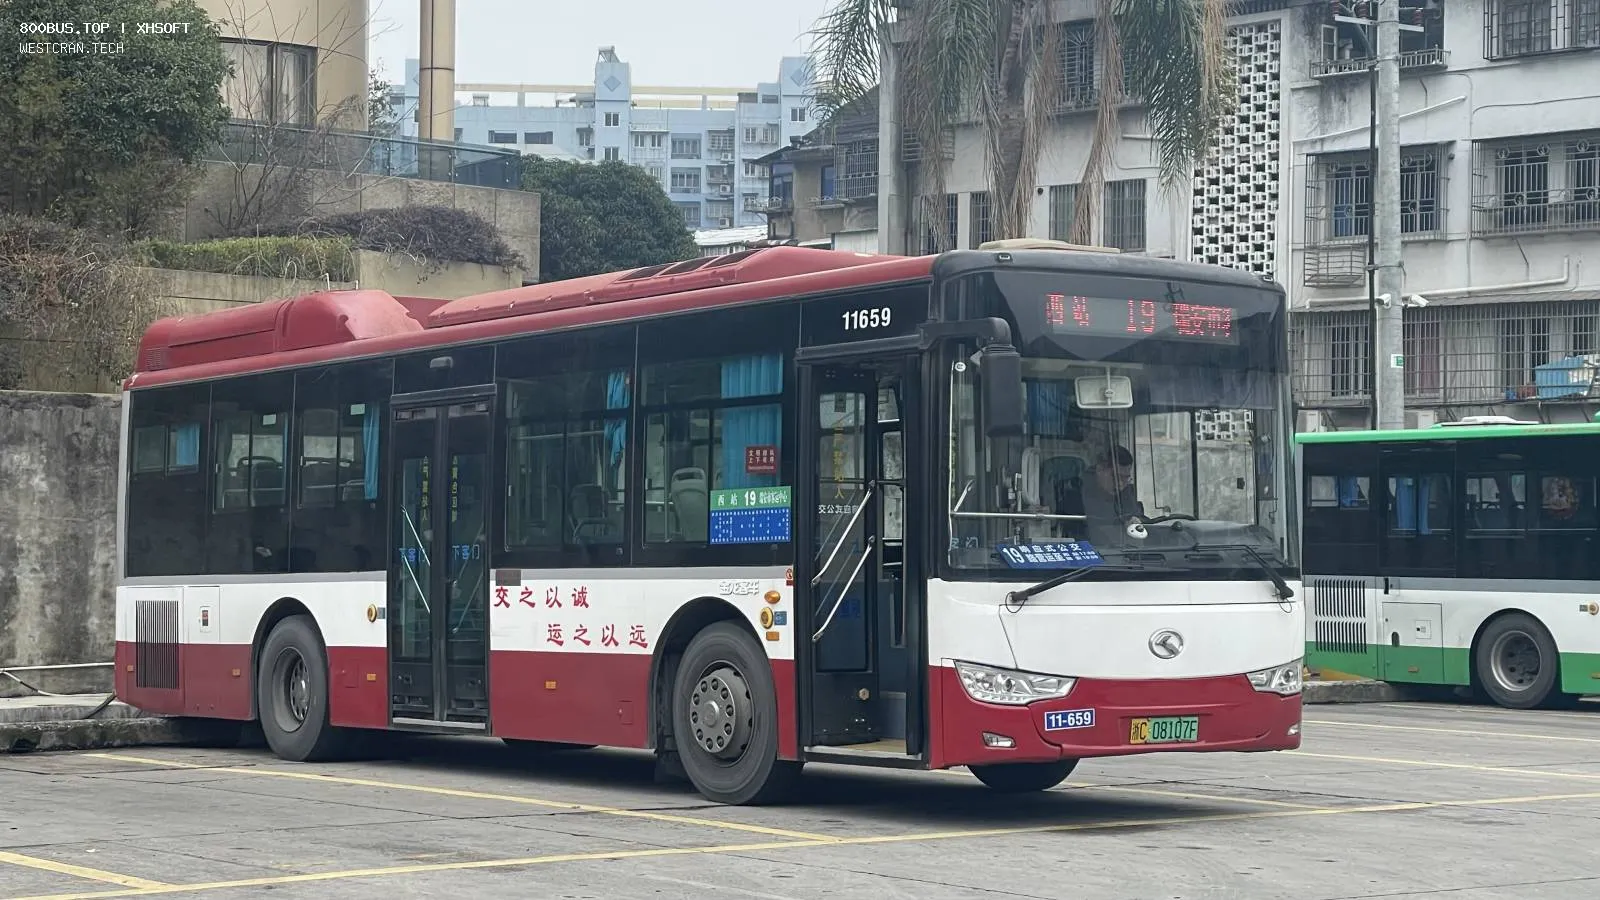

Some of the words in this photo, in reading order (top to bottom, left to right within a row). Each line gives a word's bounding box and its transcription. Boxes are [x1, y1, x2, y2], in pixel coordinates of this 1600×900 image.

[842, 307, 892, 331] 11659
[1126, 299, 1156, 333] 19
[744, 490, 757, 507] 19
[1001, 546, 1026, 564] 19
[493, 585, 591, 609] 交之以诚
[546, 623, 650, 649] 运之以远
[1048, 710, 1092, 728] 11-659
